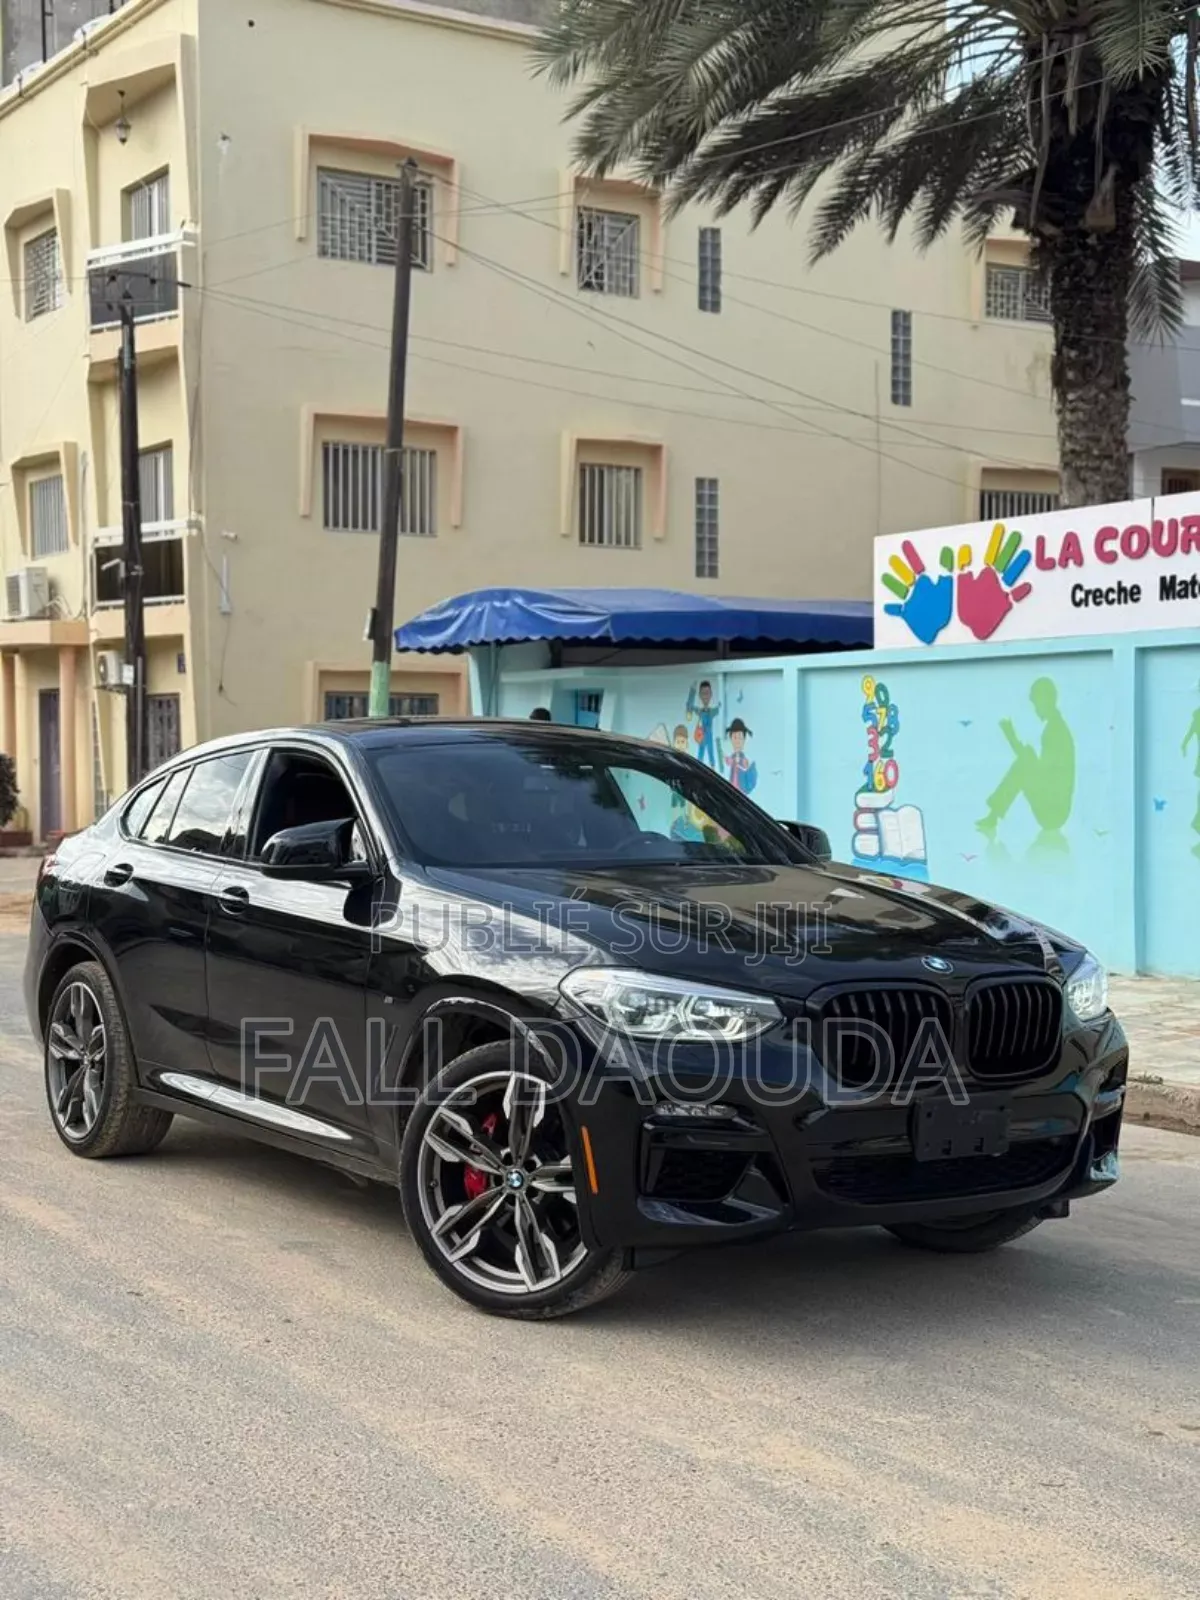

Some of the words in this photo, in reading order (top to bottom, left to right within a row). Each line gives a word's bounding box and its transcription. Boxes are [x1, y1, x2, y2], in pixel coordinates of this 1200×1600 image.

[1035, 531, 1084, 571] LA
[1094, 514, 1200, 564] COUR
[1071, 580, 1142, 608] Creche
[1159, 573, 1200, 602] Mat
